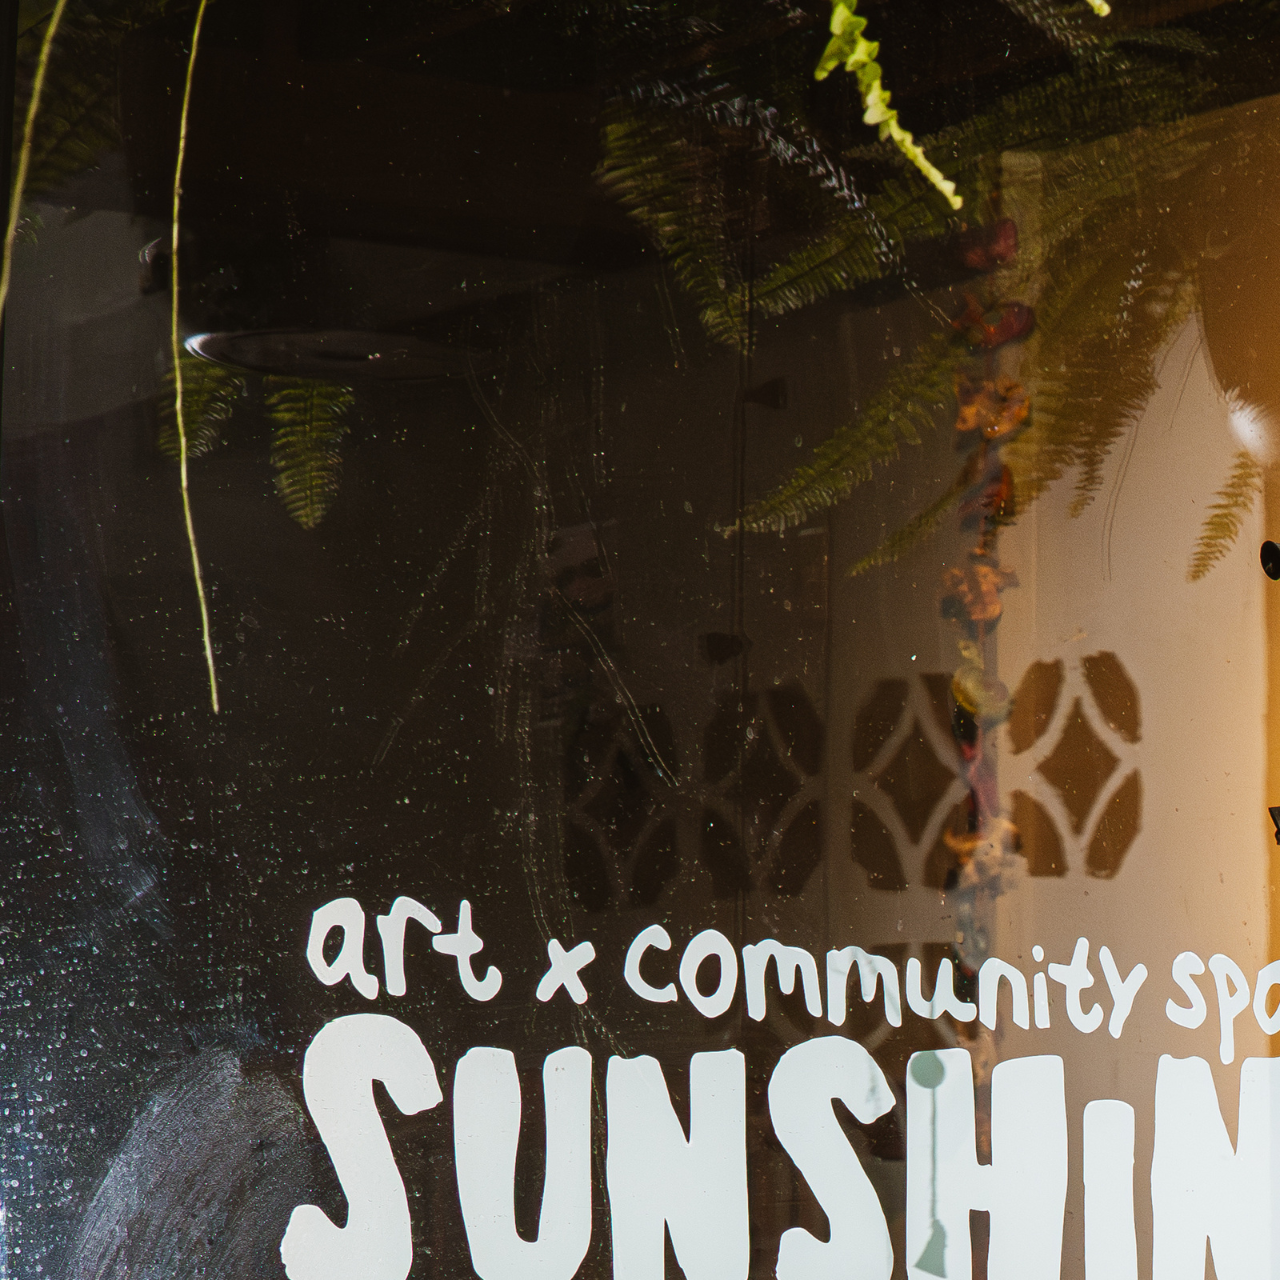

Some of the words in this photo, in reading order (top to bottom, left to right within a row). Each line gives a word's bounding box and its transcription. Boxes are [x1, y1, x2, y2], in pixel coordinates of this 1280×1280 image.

[307, 897, 501, 1001] art
[537, 939, 595, 1004] x
[625, 925, 1148, 1041] community
